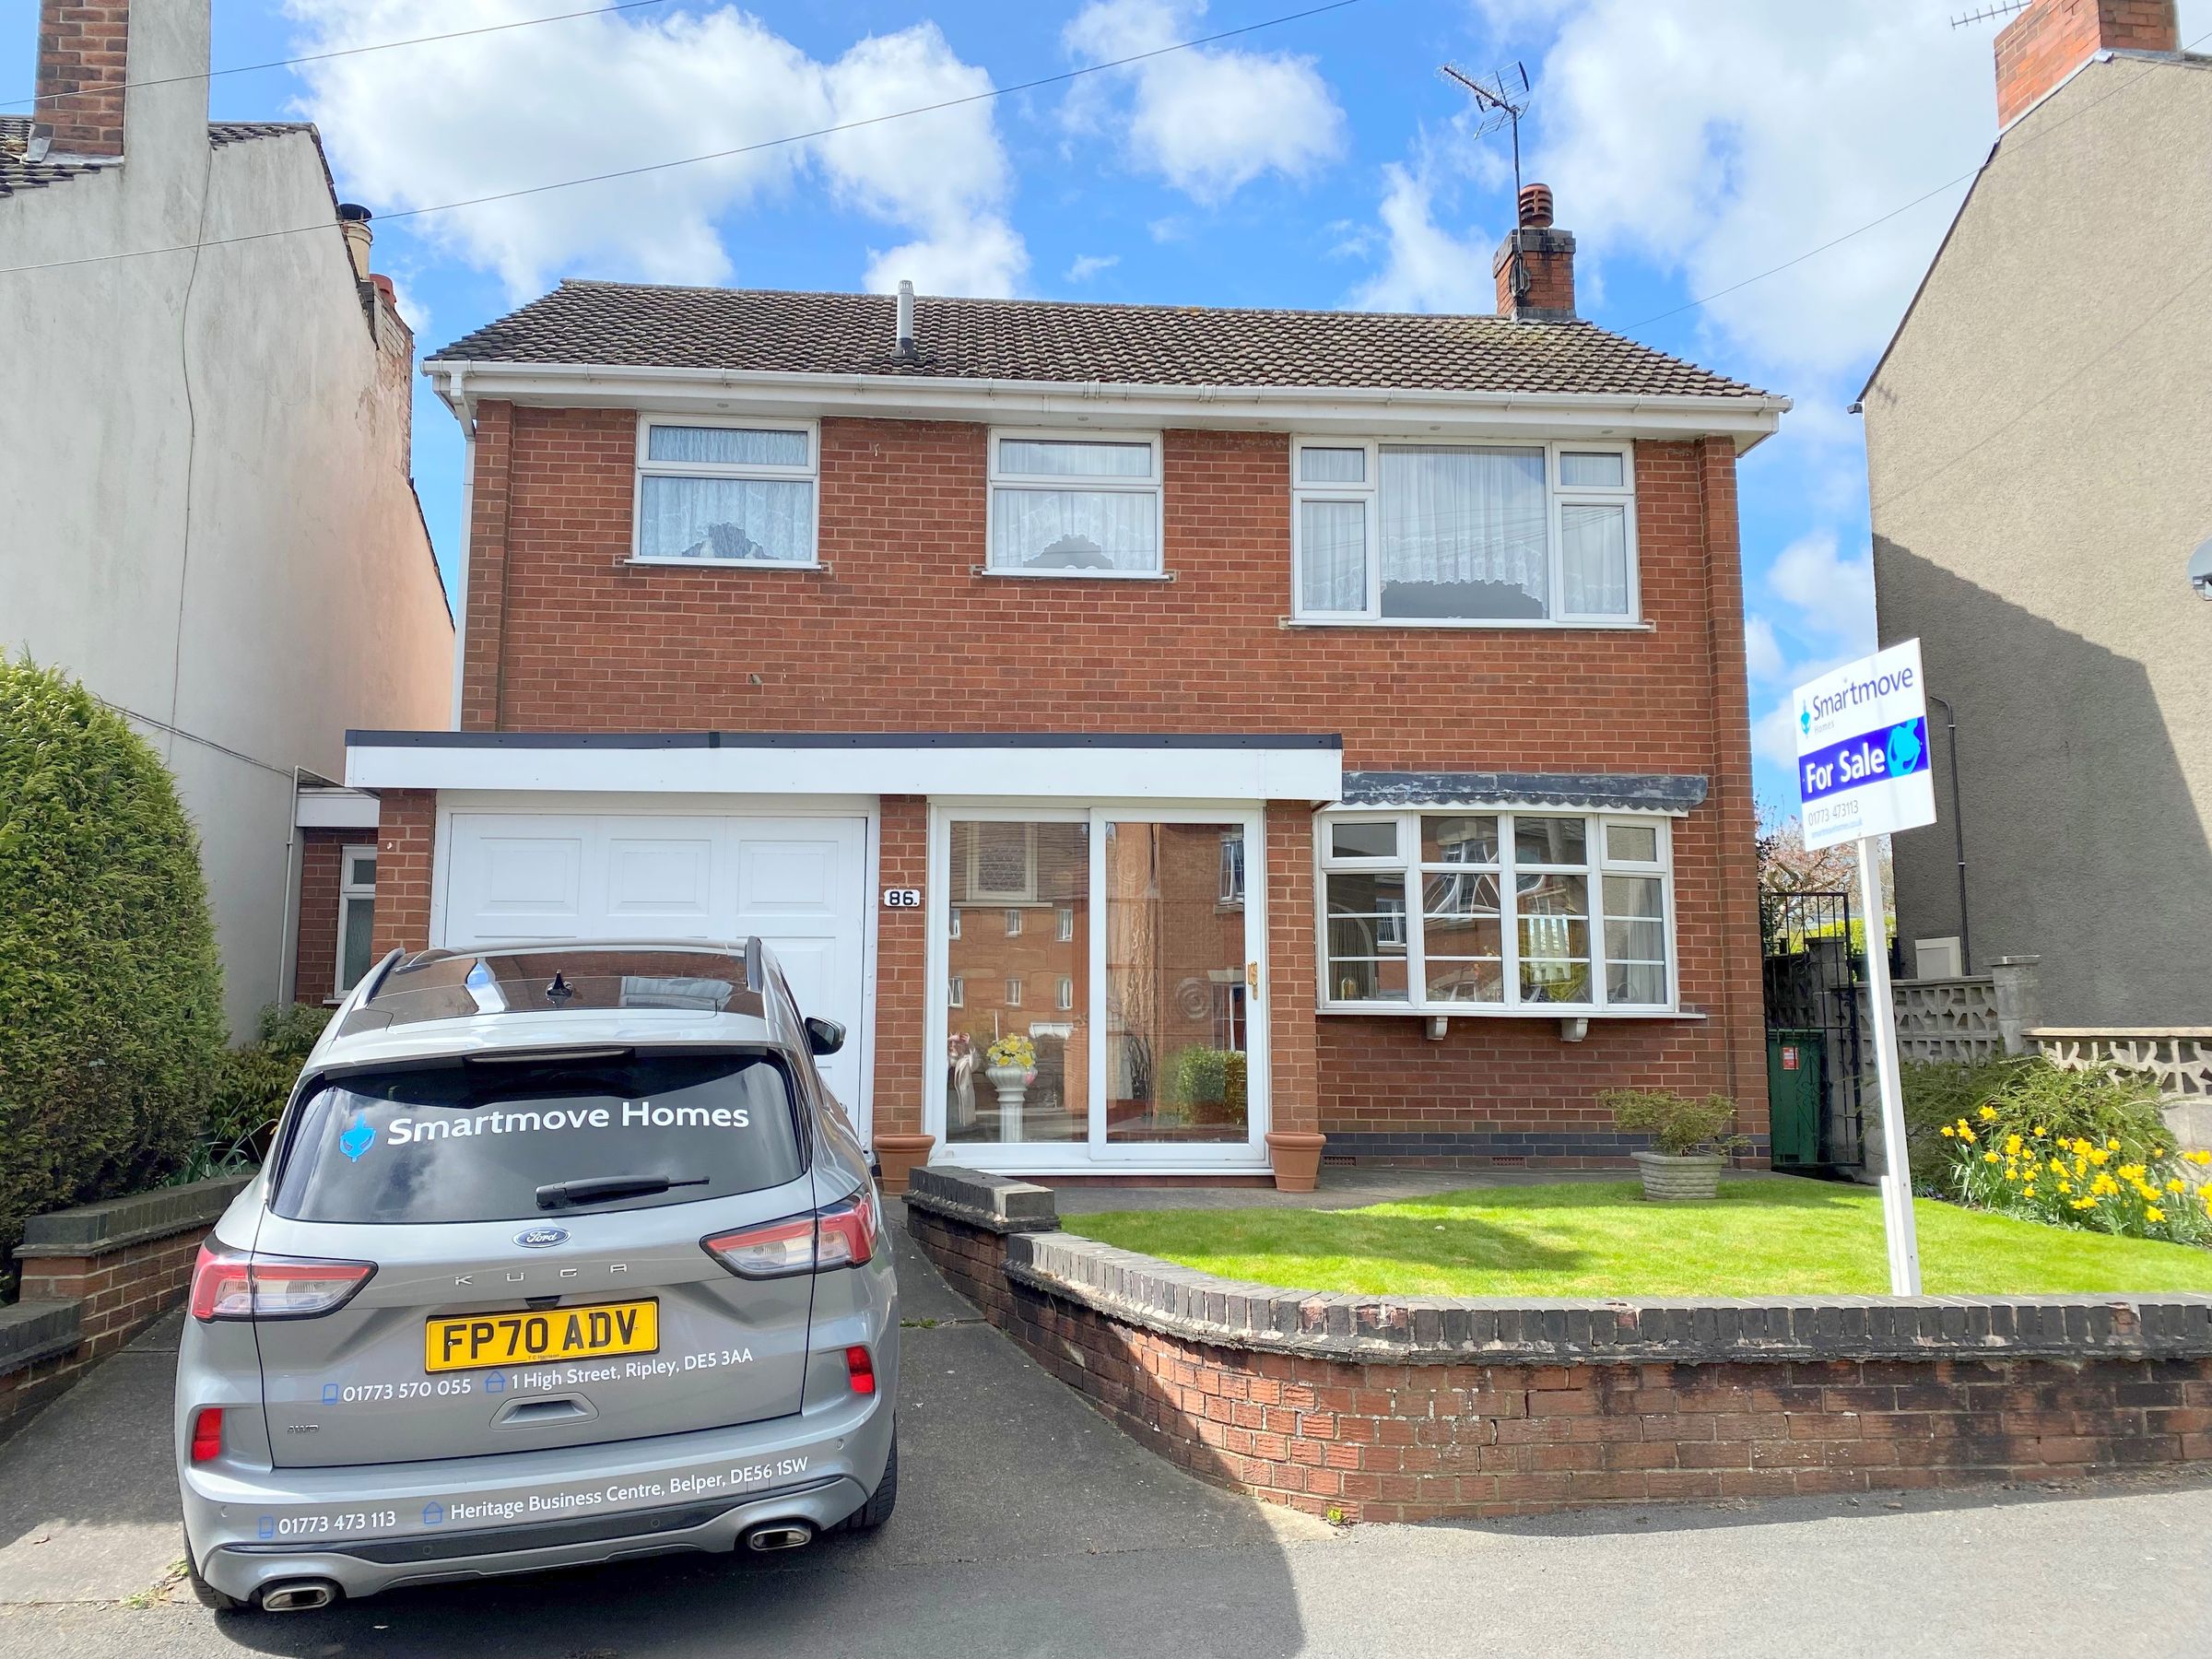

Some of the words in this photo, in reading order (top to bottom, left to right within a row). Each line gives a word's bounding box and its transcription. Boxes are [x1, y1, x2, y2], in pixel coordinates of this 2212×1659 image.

[1813, 667, 1913, 721] Smartmove
[1814, 720, 1835, 735] Homes
[1806, 760, 1834, 794] For
[1839, 742, 1886, 782] Sale
[1808, 808, 1830, 827] 01773
[1832, 799, 1859, 818] 473113
[387, 1107, 609, 1146] Smartmove
[621, 1101, 749, 1128] Homes
[526, 1230, 558, 1243] Ford
[443, 1318, 548, 1362] FP70
[563, 1310, 637, 1351] ADV
[343, 1383, 394, 1402] 01773
[398, 1381, 432, 1398] 570
[437, 1378, 471, 1395] 055
[512, 1374, 518, 1389] 1
[524, 1370, 562, 1390] High
[567, 1365, 620, 1384] Street,
[626, 1358, 680, 1381] Ripley,
[684, 1352, 717, 1371] DE5
[721, 1347, 753, 1366] 3AA
[451, 1500, 524, 1519] Heritage
[528, 1490, 602, 1512] Business
[606, 1483, 665, 1502] Centre,
[669, 1474, 725, 1495] Belper,
[730, 1464, 773, 1484] DE56
[776, 1456, 808, 1476] 1SW
[278, 1515, 329, 1535] 01773
[334, 1512, 366, 1531] 473
[371, 1511, 396, 1527] 113
